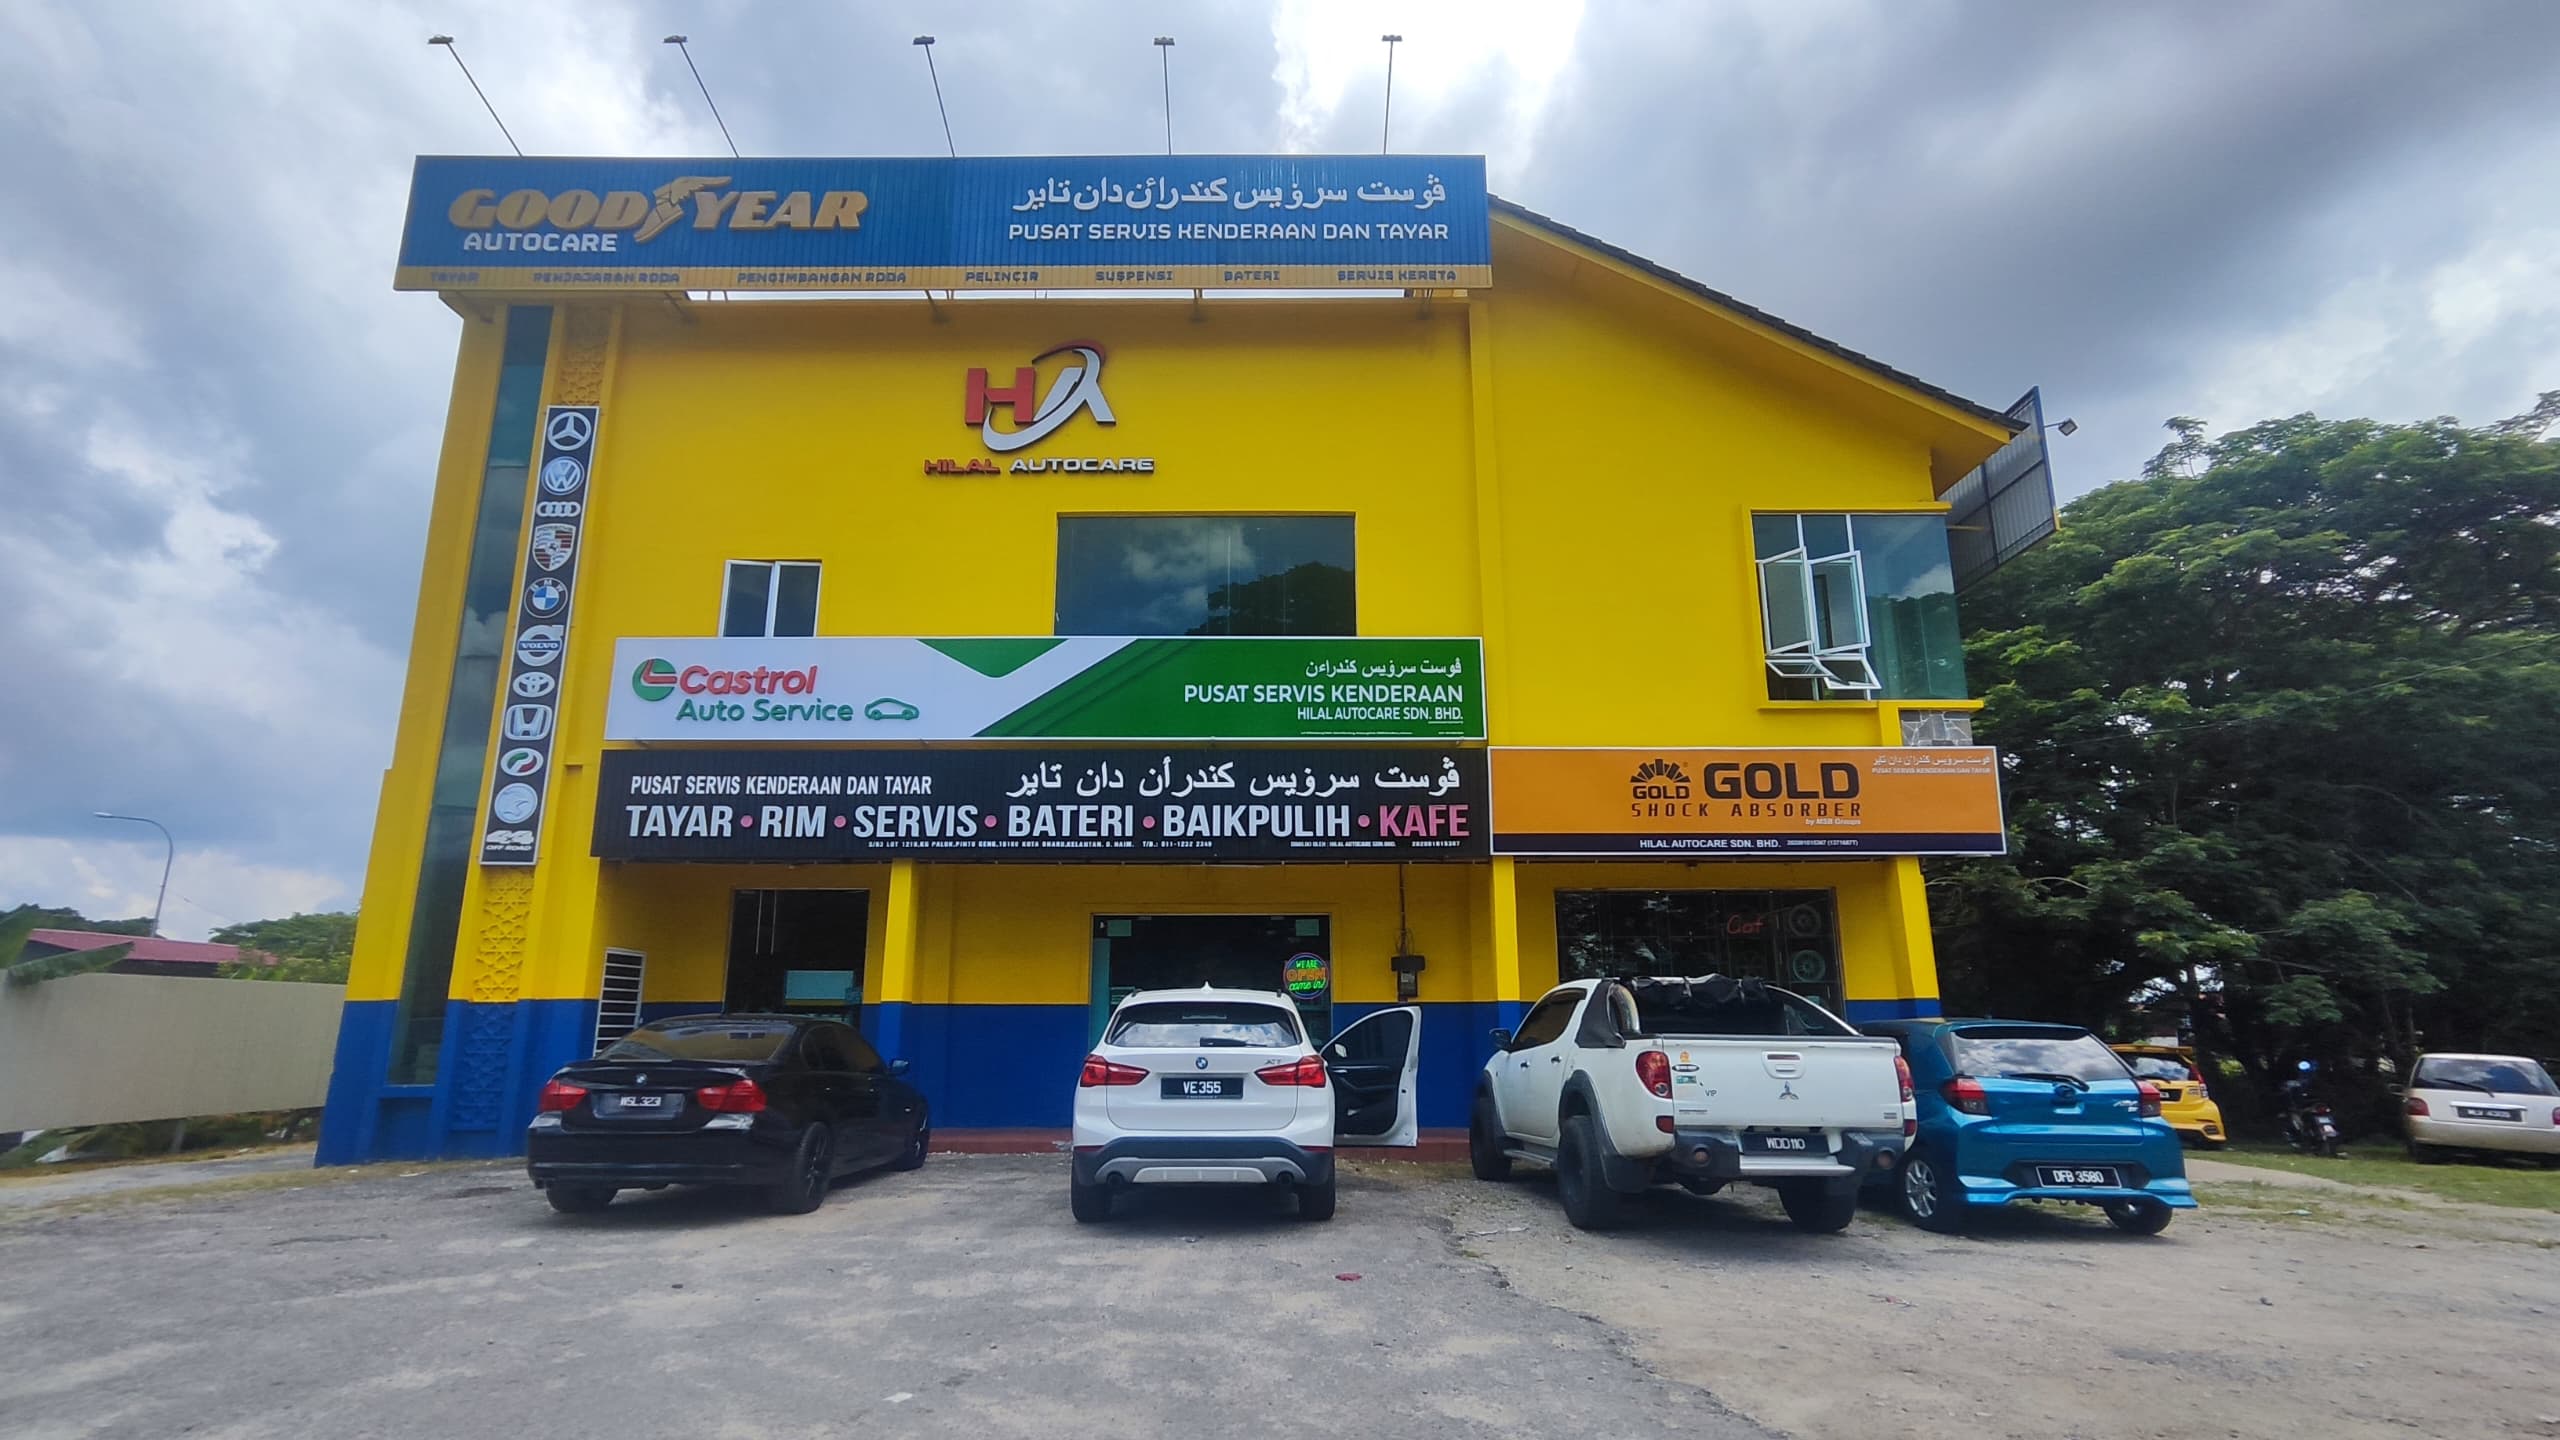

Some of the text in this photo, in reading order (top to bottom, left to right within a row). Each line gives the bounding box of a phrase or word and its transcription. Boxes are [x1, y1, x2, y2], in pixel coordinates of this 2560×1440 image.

[1008, 223, 1449, 241] PUSAT SERVIS KENDERAAN DAN TAYAR
[463, 232, 618, 252] AUTOCARE
[429, 271, 480, 283] TAYAR
[533, 271, 681, 284] PENJAJARAN RODA
[736, 271, 907, 284] PENGIMBANGAN RODA
[965, 270, 1039, 283] PELINCIR
[1095, 270, 1174, 283] SUSPENSI
[1224, 270, 1280, 283] BATERI
[1337, 270, 1457, 283] SERVIS KERETA
[924, 458, 1155, 475] HILAL AUTOCARE
[520, 641, 560, 650] VOLVO
[679, 665, 818, 695] Castrol
[1184, 684, 1463, 703] PUSAT SERVIS KENDERAAN
[676, 698, 854, 721] Auto Service
[1297, 706, 1463, 720] HILAL AUTOCARE SDN. BHD.
[630, 775, 932, 795] PUSAT SERVIS KENDERAAN DAN TAYAR
[1076, 761, 1124, 797] دان
[1703, 762, 1860, 800] GOLD
[1632, 785, 1690, 800] GOLD
[1631, 803, 1861, 817] SHOCK ABSORBER
[625, 804, 1470, 838] TAYAR RIM SERVIS BATERI BAIKPULIH KAFE
[1805, 818, 1815, 826] by
[1021, 840, 1039, 848] KOTA
[1639, 839, 1671, 849] HILAL
[1672, 839, 1729, 849] AUTOCARE
[1730, 839, 1755, 849] SDN.
[1756, 839, 1782, 849] BHD.
[1296, 960, 1318, 968] WE ARE
[1286, 968, 1326, 981] OPEN
[2052, 1170, 2104, 1183] DFB 3580
